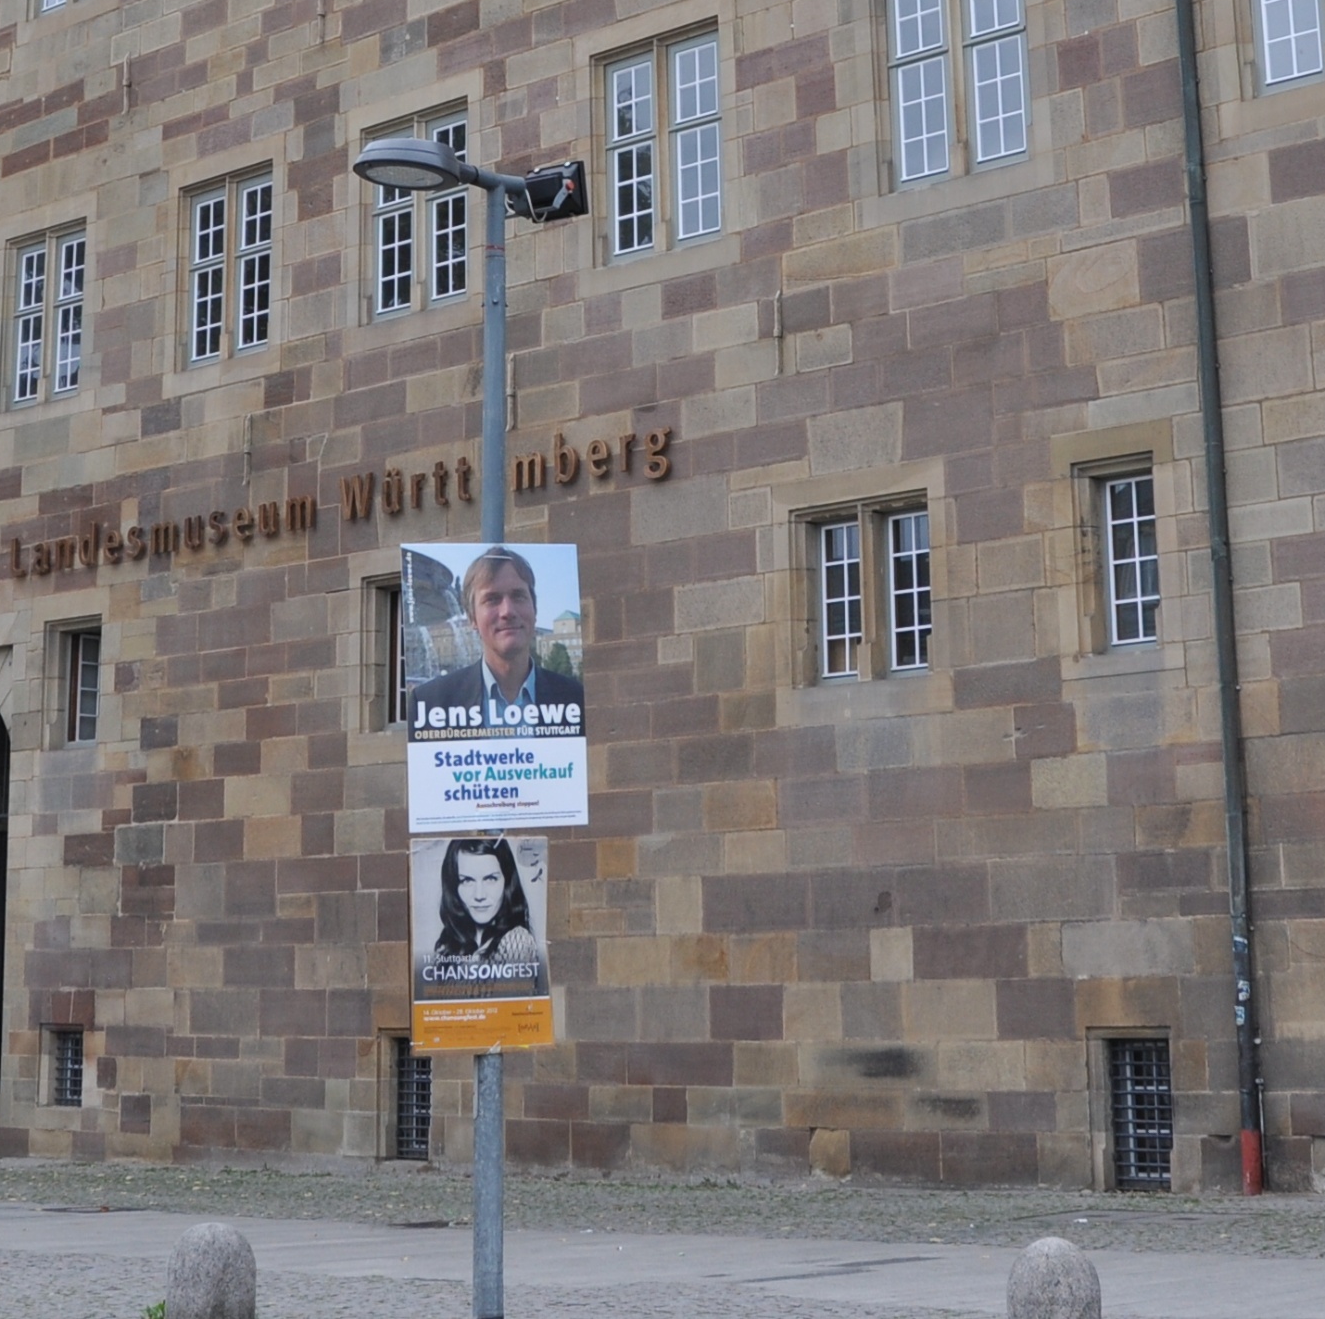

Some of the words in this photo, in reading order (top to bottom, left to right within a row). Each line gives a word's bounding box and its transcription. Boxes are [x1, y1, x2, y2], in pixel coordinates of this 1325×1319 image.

[10, 490, 316, 579] Landesmuseum
[340, 425, 671, 521] Württmberg
[414, 701, 482, 729] Jens
[489, 699, 581, 725] Loewe
[414, 727, 515, 740] OBERBÜRGERMEISTER
[516, 725, 534, 737] FÜR
[535, 725, 580, 736] STUTTGART
[434, 747, 534, 767] Stadtwerke
[453, 768, 480, 783] vor
[484, 762, 574, 782] Ausverkauf
[444, 784, 519, 801] schützen
[436, 954, 480, 964] Stuttgarter
[422, 962, 540, 981] CHANSONGFEST
